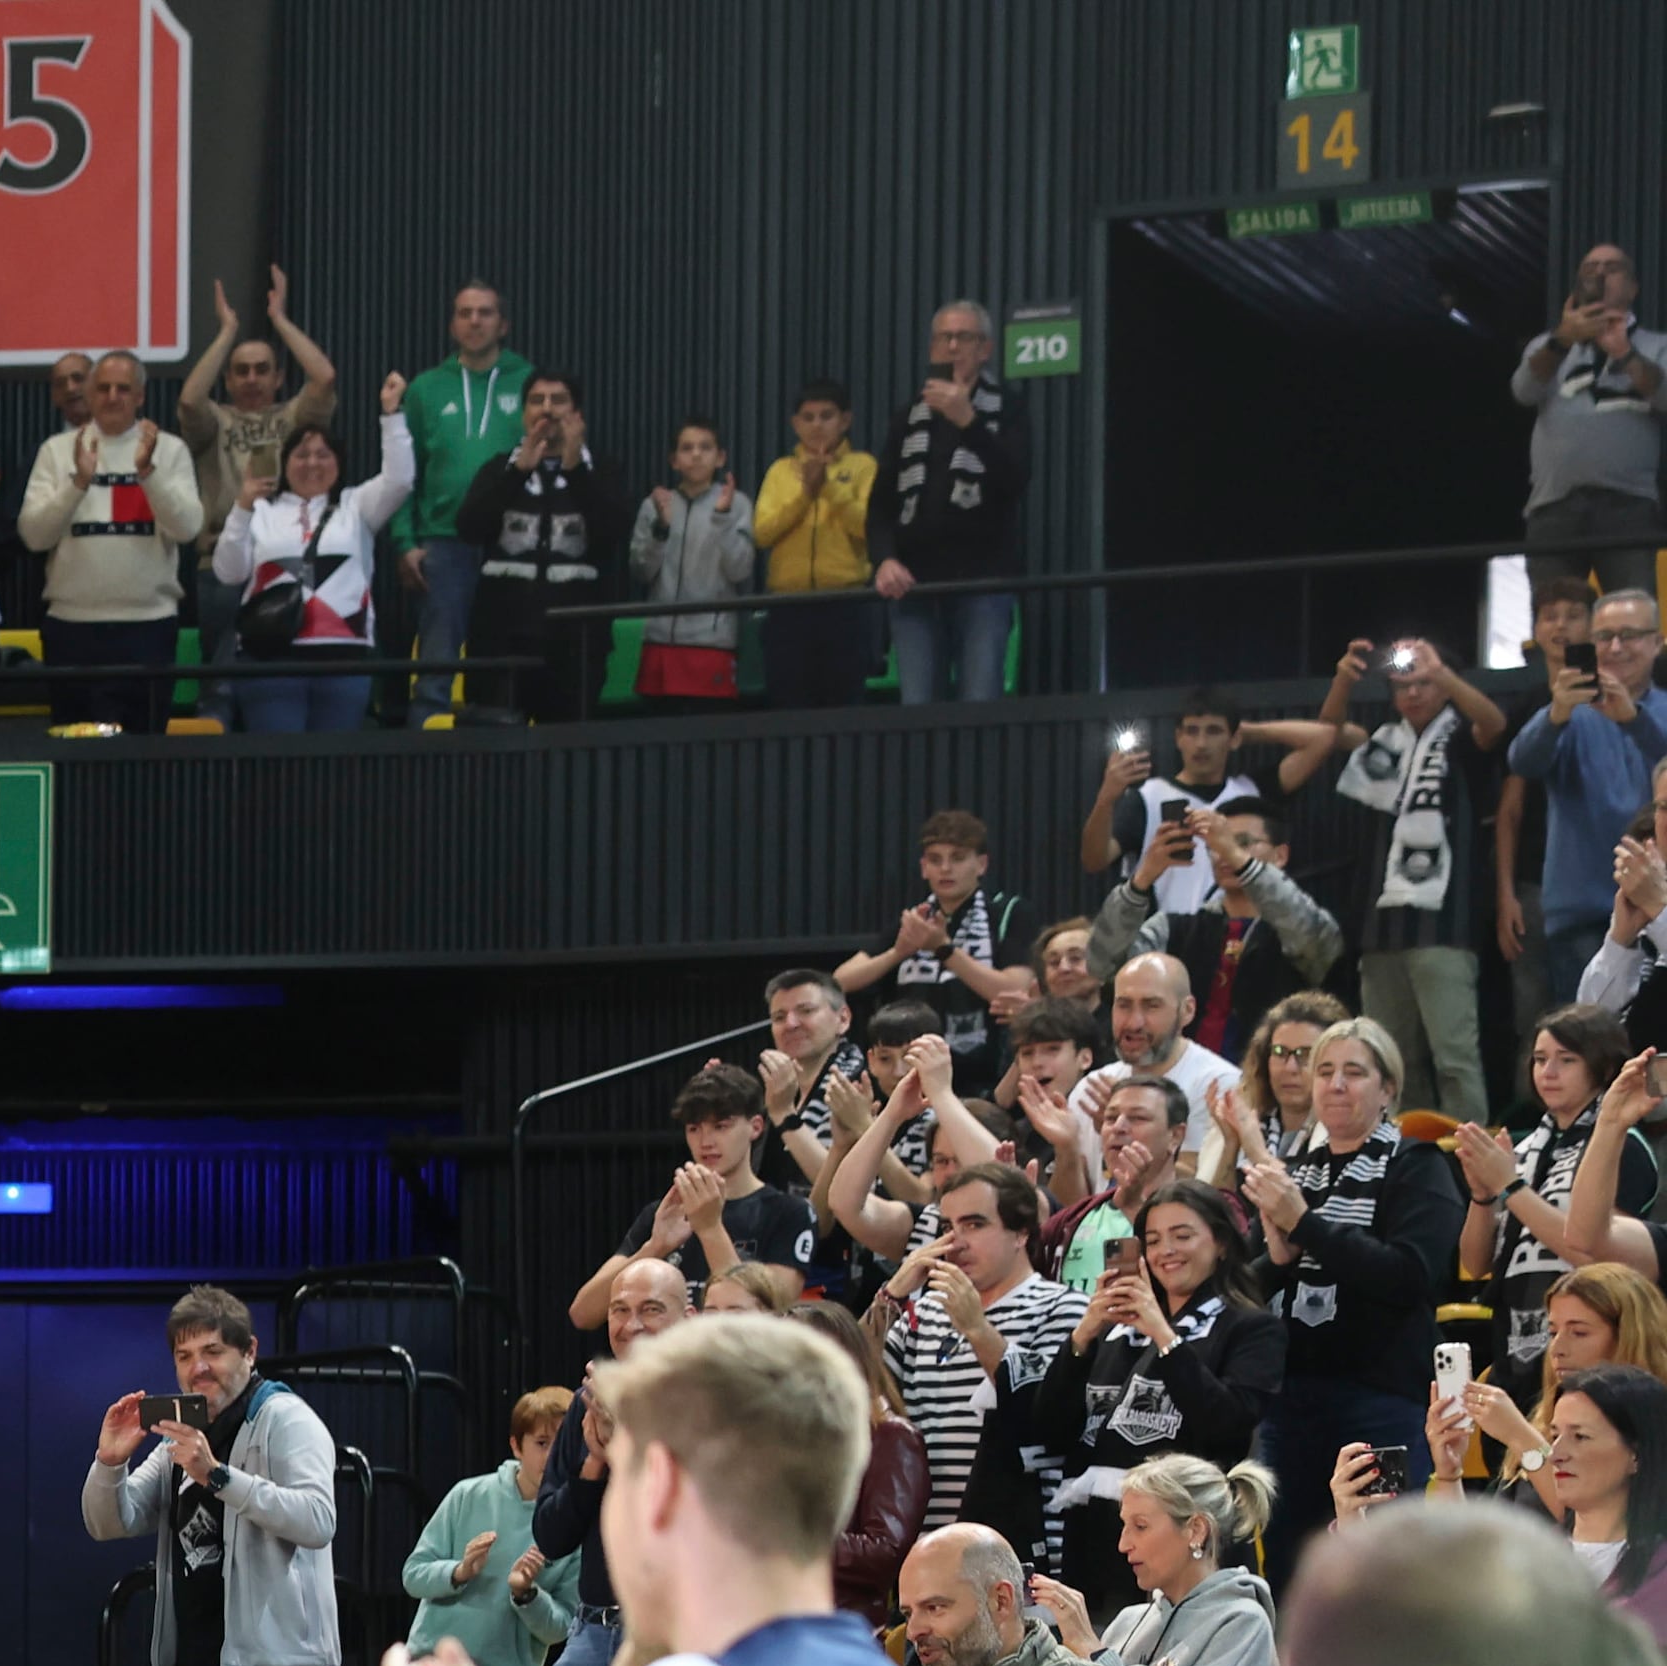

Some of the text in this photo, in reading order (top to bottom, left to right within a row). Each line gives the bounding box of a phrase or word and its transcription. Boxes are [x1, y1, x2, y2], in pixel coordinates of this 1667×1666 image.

[1287, 109, 1359, 174] 14
[1236, 206, 1312, 236] SALIDA
[1016, 334, 1069, 365] 210
